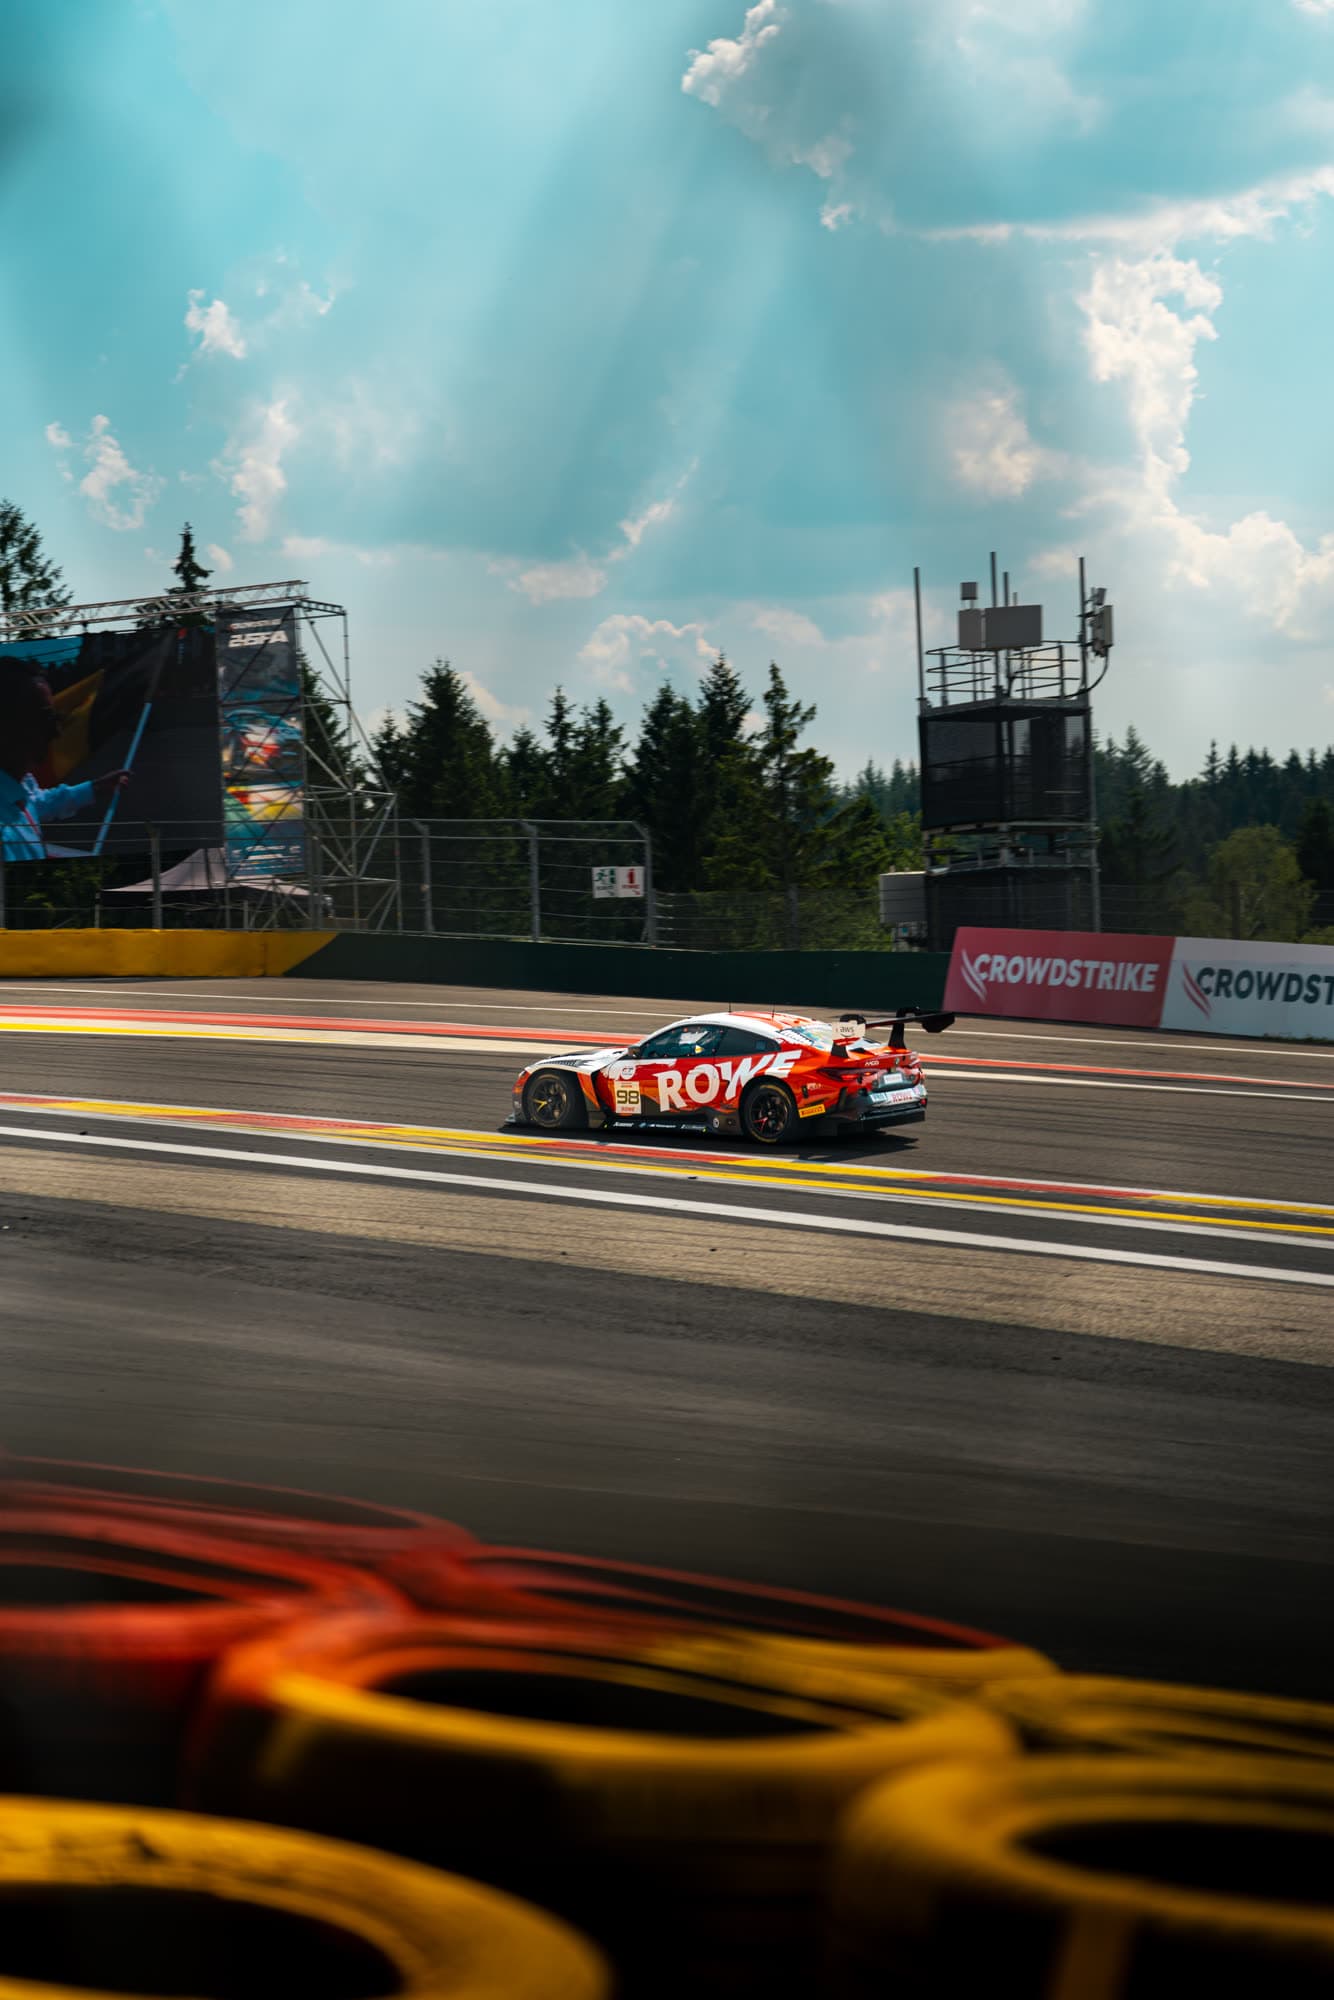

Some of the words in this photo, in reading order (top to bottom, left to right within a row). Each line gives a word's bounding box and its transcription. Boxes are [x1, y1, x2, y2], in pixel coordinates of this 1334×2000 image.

[974, 952, 1158, 992] CROWDSTRIKE
[616, 1089, 640, 1105] 98
[653, 1049, 803, 1113] ROWE
